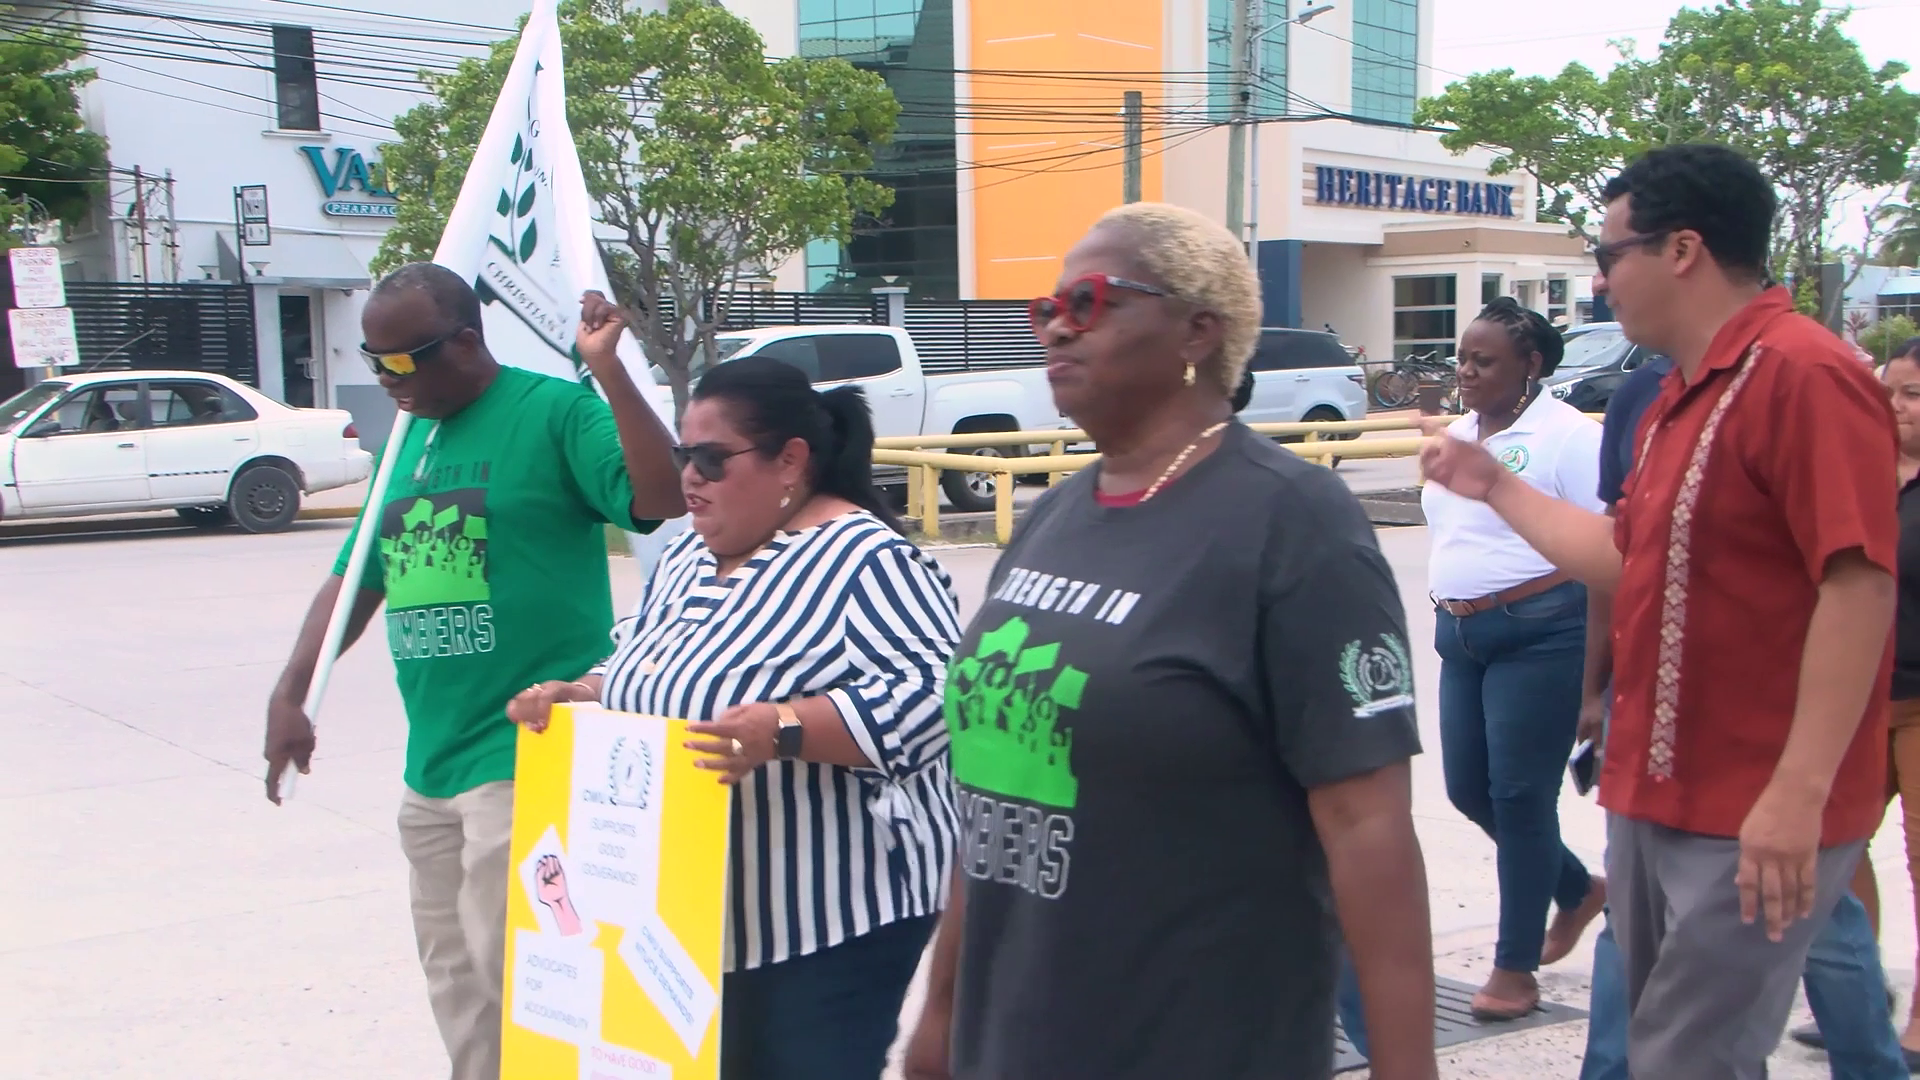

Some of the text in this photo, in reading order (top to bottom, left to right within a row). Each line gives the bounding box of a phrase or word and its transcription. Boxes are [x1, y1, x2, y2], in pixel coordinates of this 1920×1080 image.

[1316, 166, 1515, 217] HERITAGE BANK
[332, 202, 398, 218] PHARMAC
[992, 567, 1142, 626] TRENGTH IN
[591, 816, 638, 838] SUPPORTS
[598, 841, 628, 860] GOOD
[960, 790, 1076, 900] MBERS
[525, 953, 579, 981] ADVOCATES
[658, 948, 695, 1001] SUPPORTS
[525, 976, 544, 993] FOR
[523, 1000, 590, 1031] ACCOUNTABILITY
